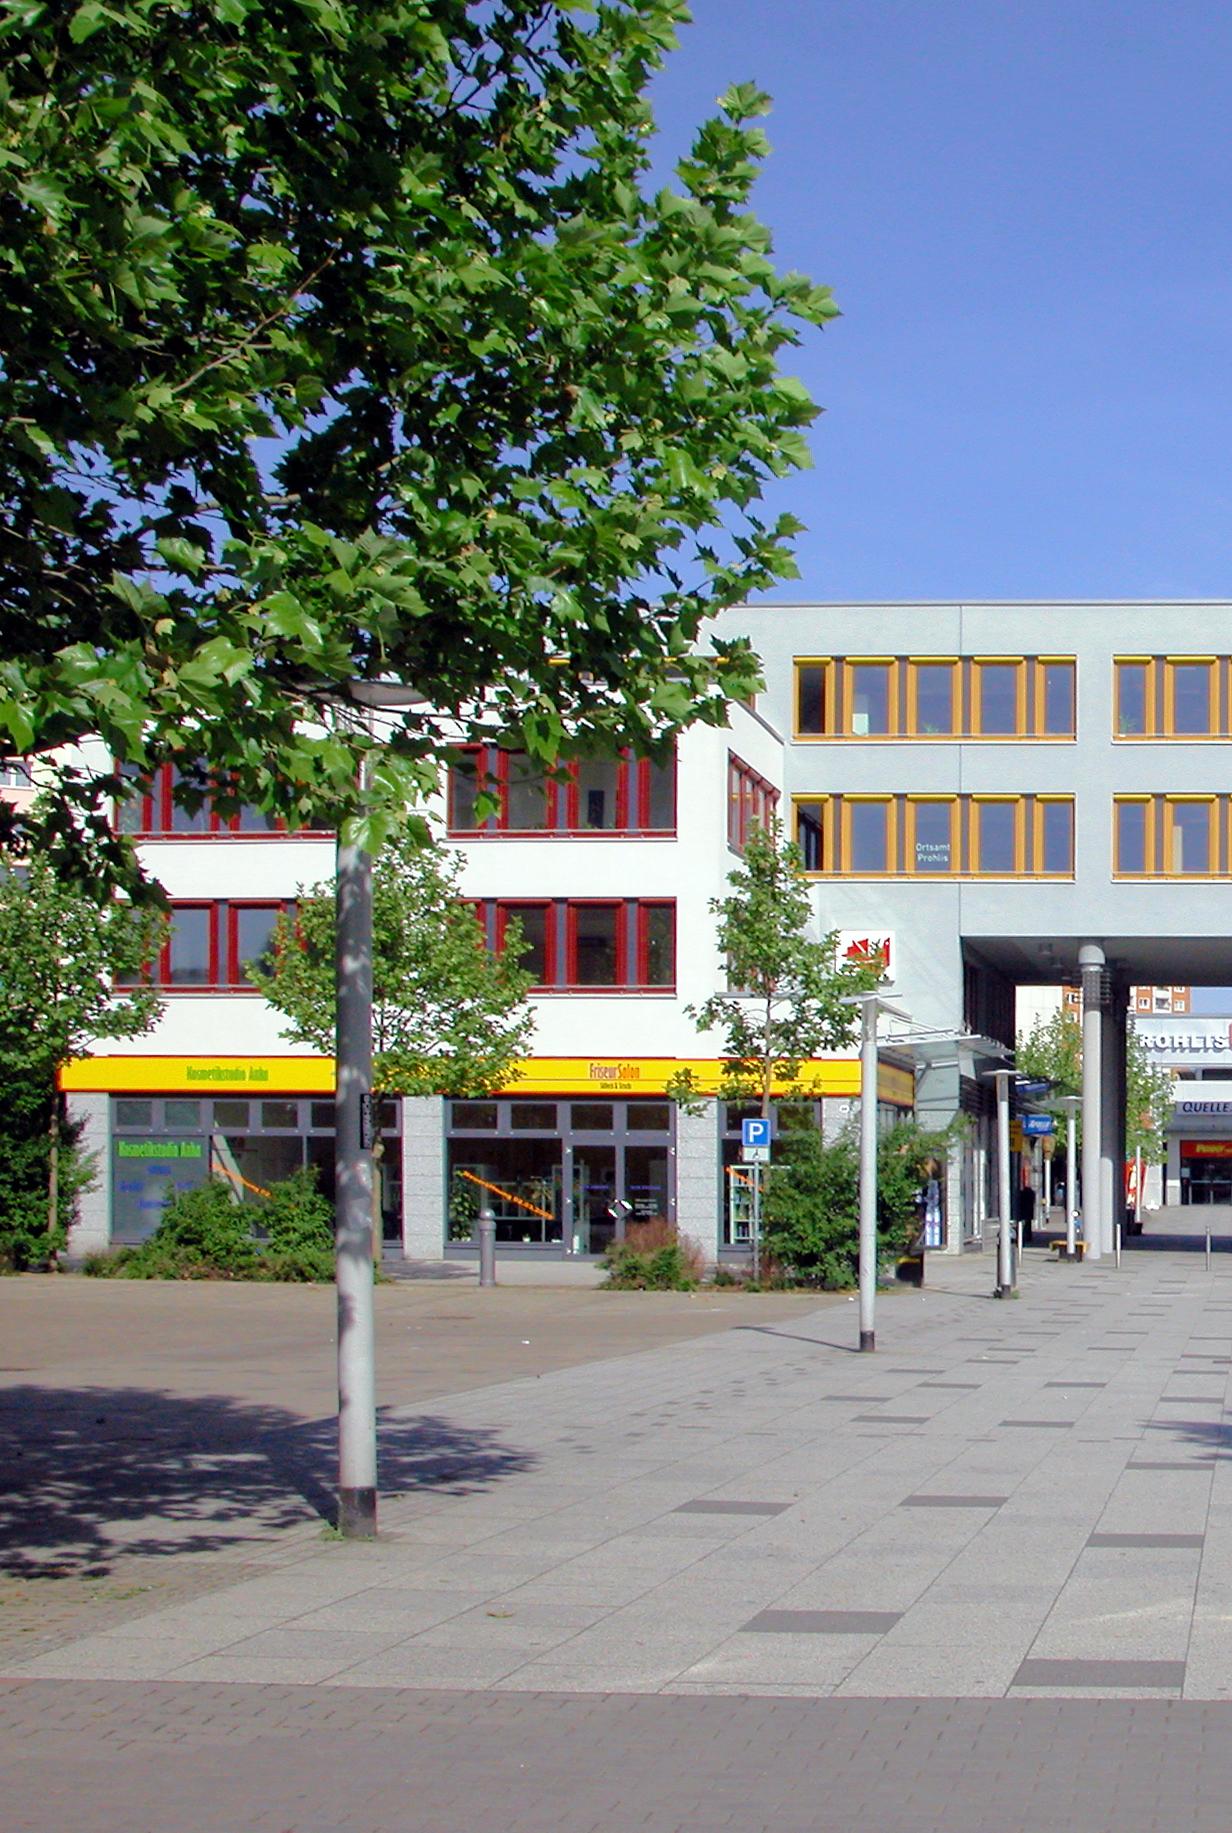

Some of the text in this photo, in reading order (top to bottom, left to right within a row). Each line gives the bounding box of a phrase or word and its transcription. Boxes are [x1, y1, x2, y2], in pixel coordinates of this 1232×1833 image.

[916, 842, 950, 851] Ortsamt
[1139, 1035, 1225, 1051] ROHLIS
[749, 1122, 764, 1143] P
